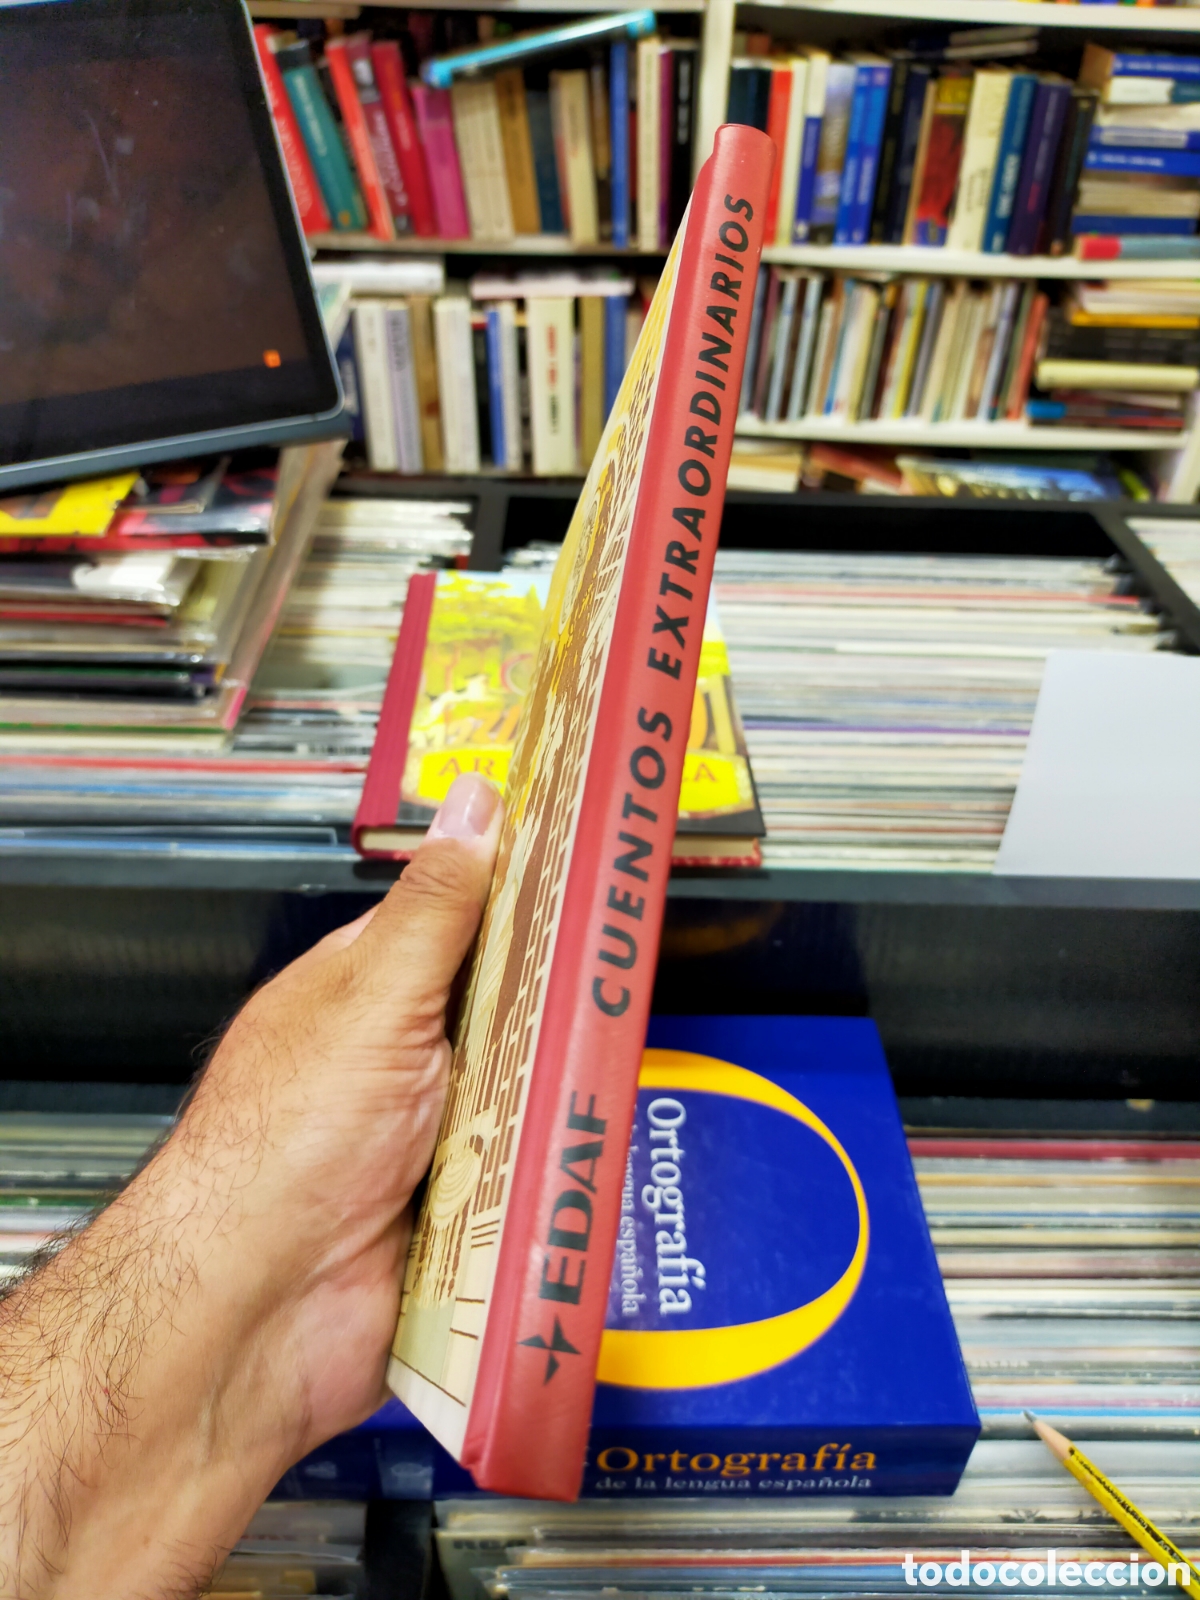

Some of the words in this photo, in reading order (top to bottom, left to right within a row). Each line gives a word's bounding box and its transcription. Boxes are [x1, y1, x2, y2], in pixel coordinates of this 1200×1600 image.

[592, 707, 673, 1017] CUENTOS
[647, 194, 754, 680] EXTRAORDINARIOS
[538, 1090, 607, 1305] EDAF
[616, 1215, 647, 1317] española
[643, 1098, 706, 1316] Ortografía
[595, 1476, 626, 1489] de
[635, 1476, 656, 1489] la
[665, 1475, 750, 1490] lengua
[758, 1475, 872, 1491] española
[597, 1443, 876, 1476] Ortografía
